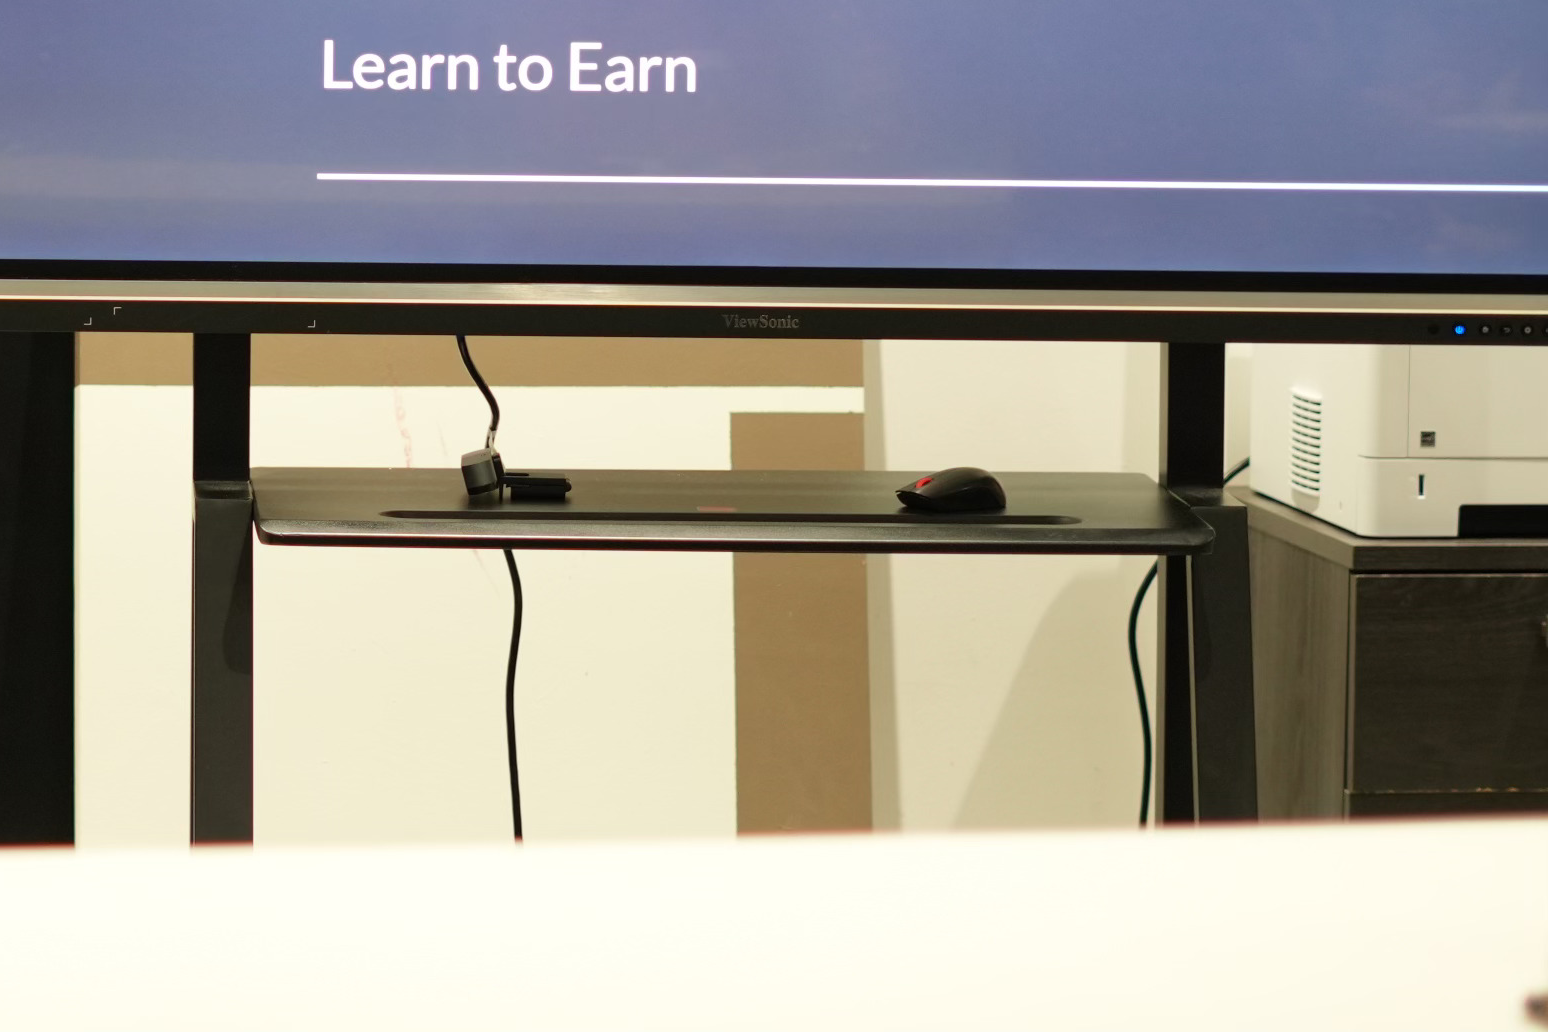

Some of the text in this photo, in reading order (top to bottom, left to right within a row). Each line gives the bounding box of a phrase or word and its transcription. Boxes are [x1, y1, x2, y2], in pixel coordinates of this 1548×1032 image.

[323, 39, 697, 93] Learn to Earn
[721, 314, 800, 329] ViewSonic
